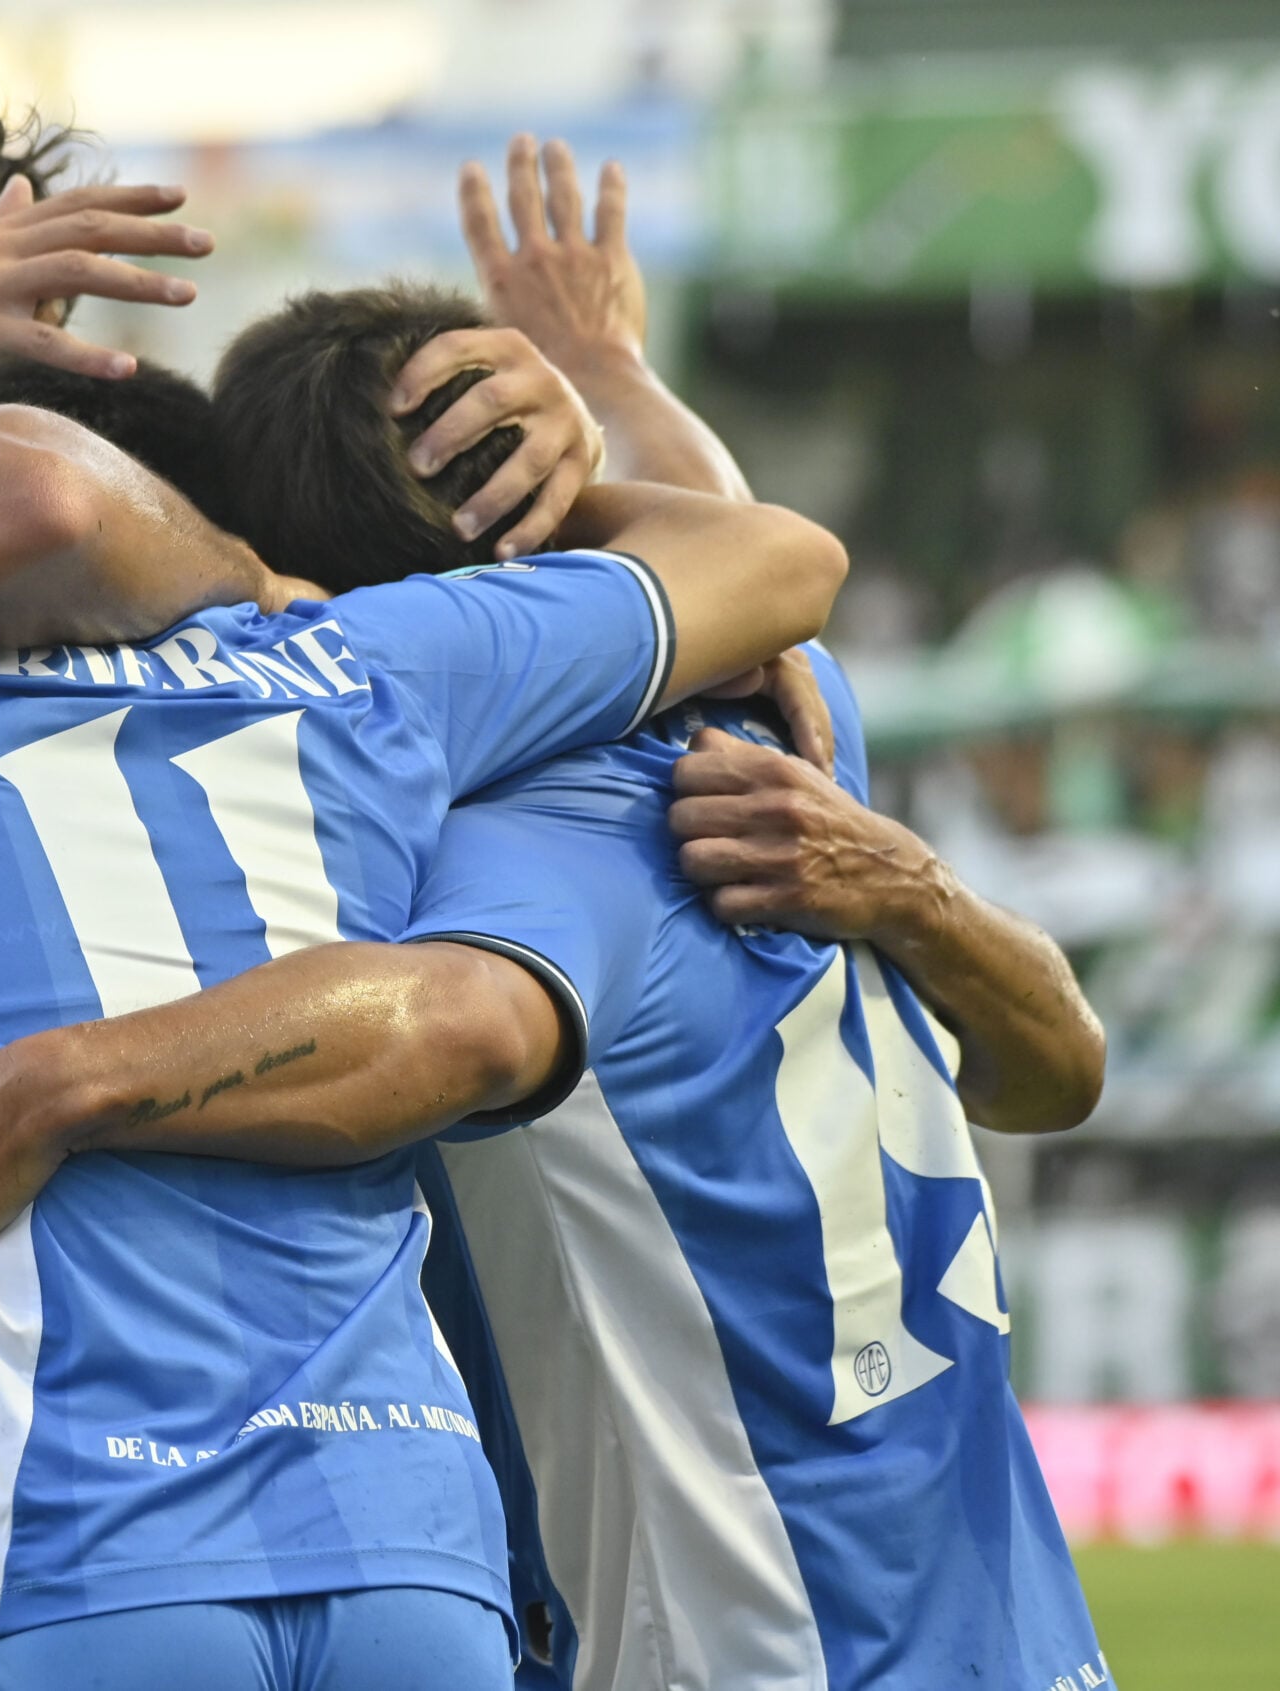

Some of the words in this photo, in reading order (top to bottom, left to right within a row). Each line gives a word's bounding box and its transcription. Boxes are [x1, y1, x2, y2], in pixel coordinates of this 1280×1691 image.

[106, 1436, 144, 1461] DE
[149, 1440, 187, 1467] LA
[388, 1403, 419, 1429] AL
[420, 1404, 480, 1443] MUNDO
